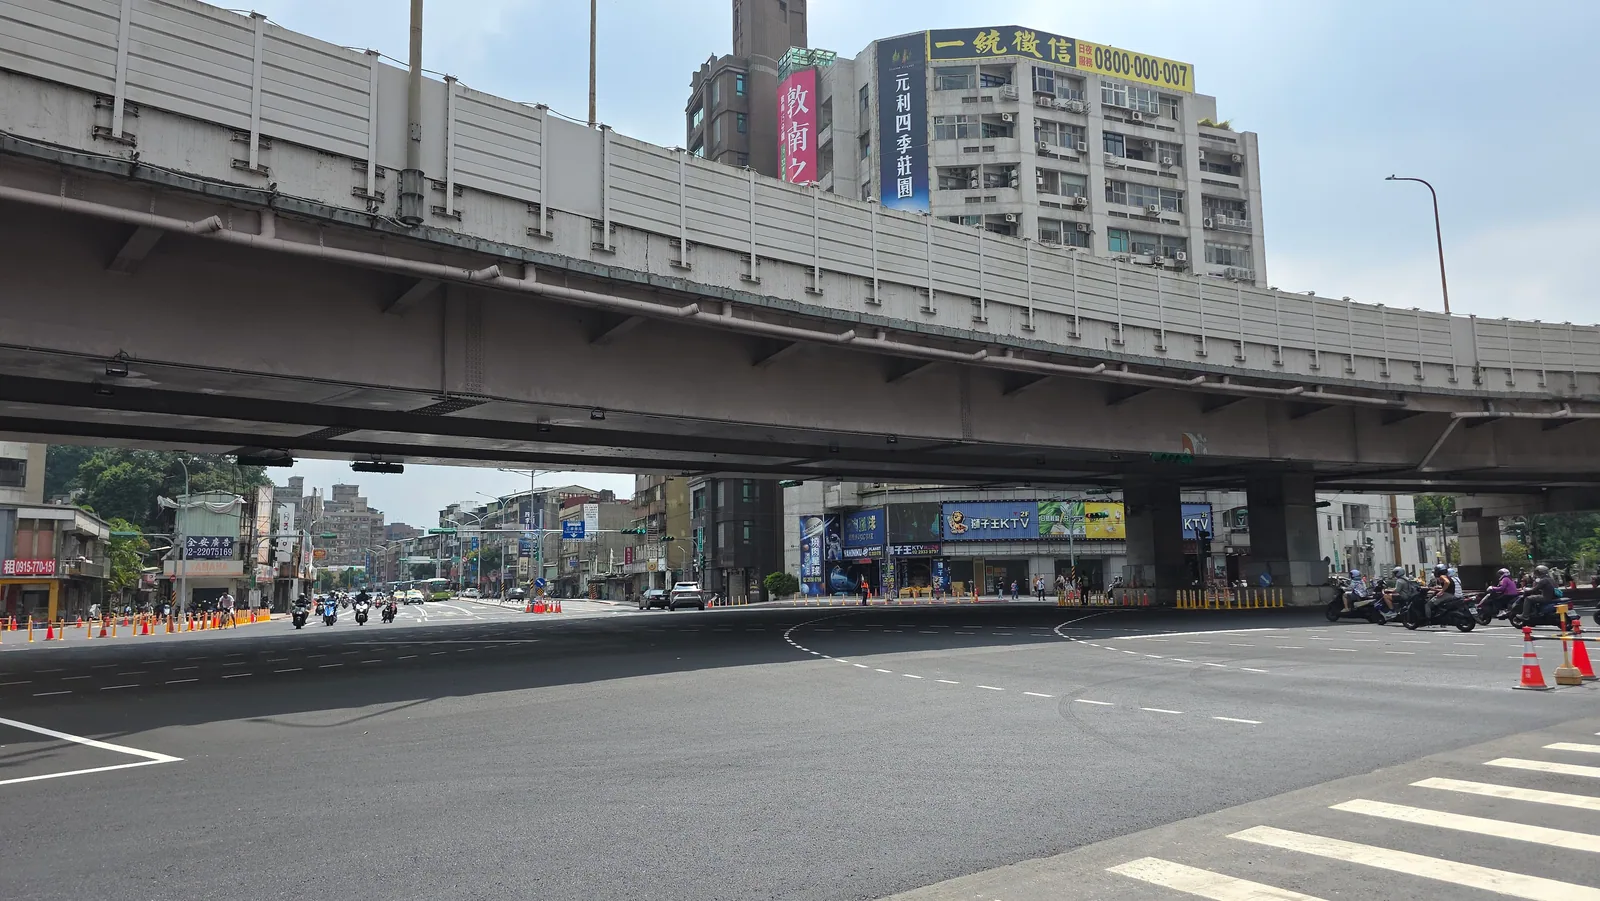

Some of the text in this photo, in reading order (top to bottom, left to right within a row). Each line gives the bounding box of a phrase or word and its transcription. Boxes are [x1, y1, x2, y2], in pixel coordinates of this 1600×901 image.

[934, 28, 1073, 64] 一統徵信
[1078, 43, 1093, 56] 日夜
[1078, 56, 1093, 68] 服務
[786, 84, 810, 186] 敦南之
[895, 73, 913, 199] 元利四季莊園
[970, 518, 1030, 530] 獅子王KTV
[1184, 518, 1209, 530] KTV
[187, 537, 231, 547] 全安廣告
[3, 560, 15, 574] 租
[15, 560, 55, 573] 0915-770-151
